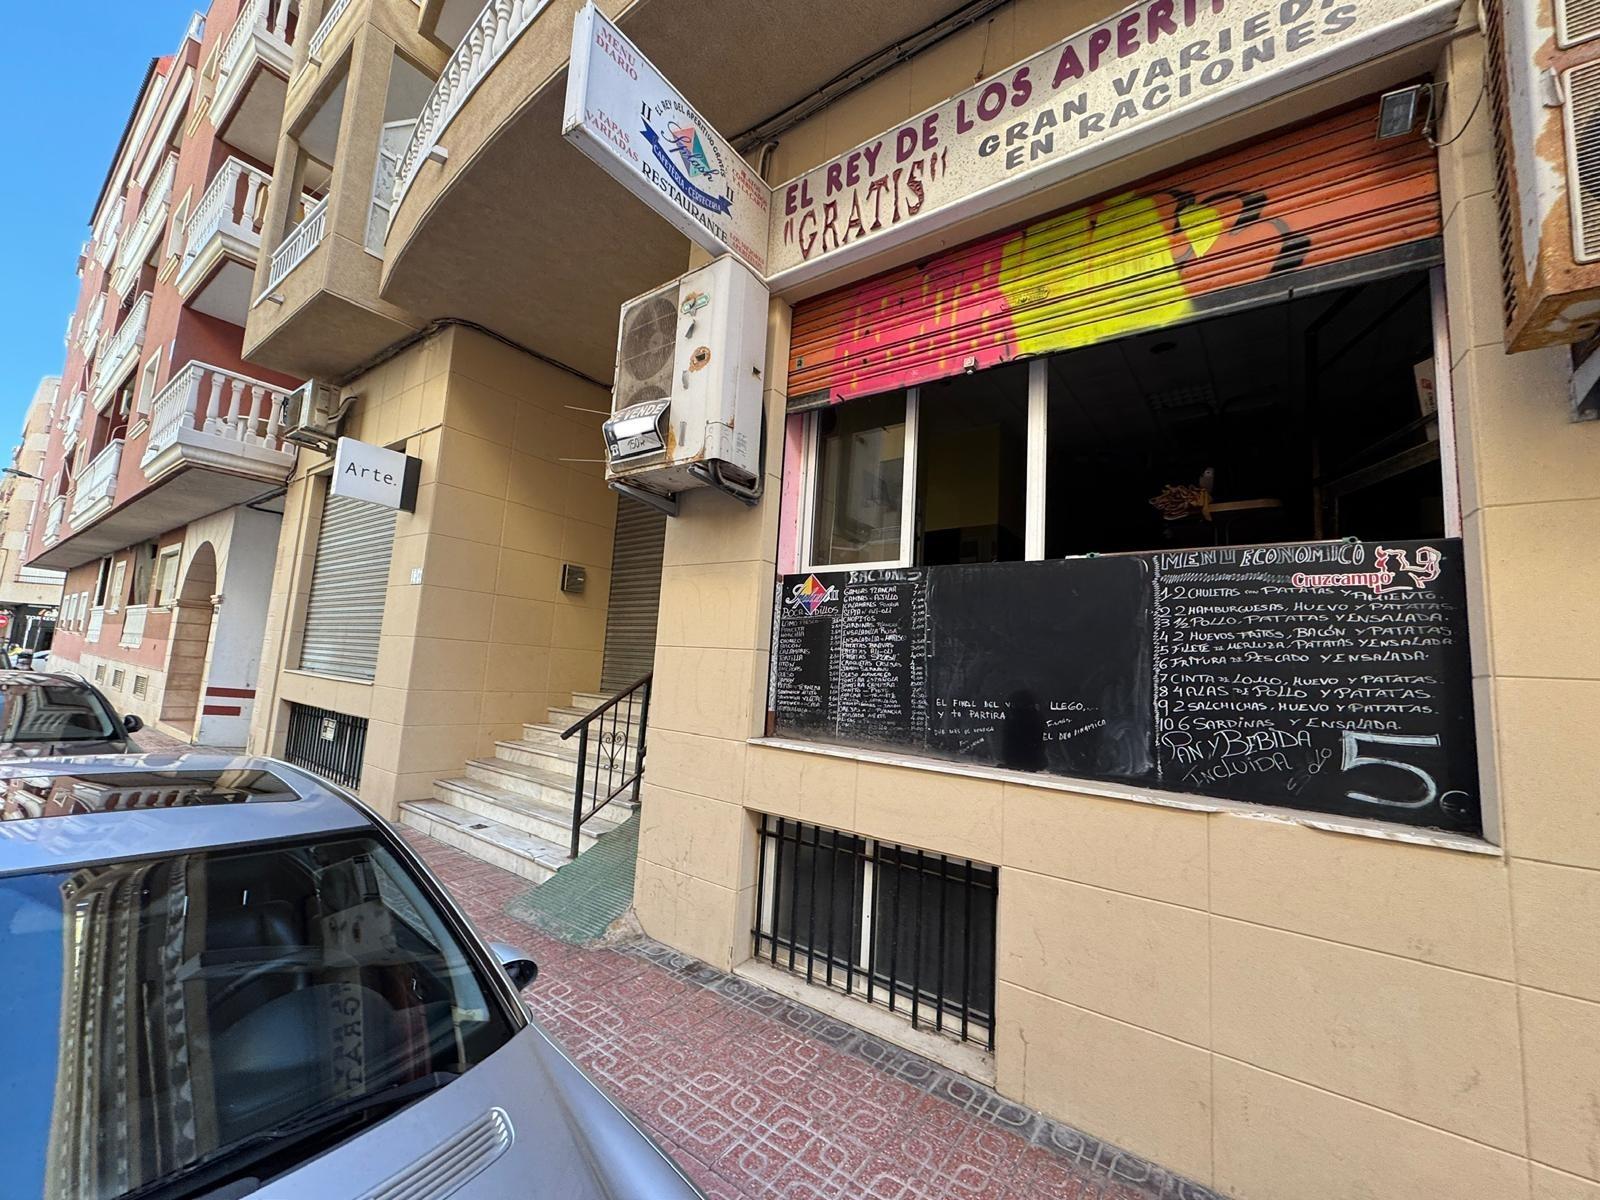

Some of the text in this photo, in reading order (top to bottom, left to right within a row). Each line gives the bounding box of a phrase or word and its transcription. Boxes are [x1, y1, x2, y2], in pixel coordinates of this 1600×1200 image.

[598, 26, 636, 66] MENU
[596, 34, 638, 81] DIARIO
[978, 0, 1335, 158] GRAN VARIED
[1006, 4, 1358, 171] EN RACIONES
[673, 101, 686, 114] DEL
[585, 108, 639, 162] VARIADAS
[598, 108, 630, 143] TAPAS
[785, 179, 813, 216] EL
[826, 141, 882, 197] REY
[896, 113, 939, 164] DE
[956, 67, 1032, 136] LOS
[642, 160, 728, 245] RESTAURANTE
[624, 403, 667, 420] VENDE
[345, 462, 398, 486] Arte.
[1160, 549, 1236, 570] MENU
[1187, 588, 1240, 599] CHULETAS
[1261, 586, 1334, 595] PATATAS
[1291, 572, 1394, 594] Cruzcampo
[1160, 606, 1172, 618] 2
[1174, 605, 1187, 616] 2
[1293, 602, 1348, 611] HUEVO
[1160, 618, 1170, 628] 3
[1243, 614, 1329, 624] PATATAS
[1336, 614, 1345, 623] Y
[1160, 631, 1168, 643] 4
[1173, 631, 1184, 642] 2
[1189, 631, 1235, 641] HUEVOS
[1355, 628, 1367, 636] Y
[1366, 625, 1453, 636] PATATAS
[1160, 645, 1169, 656] 5
[1171, 642, 1210, 655] FILETE
[1290, 639, 1354, 649] PATATAS
[1358, 639, 1368, 648] Y
[1159, 657, 1168, 670] 6
[1170, 656, 1227, 668] FRITURA
[1244, 651, 1310, 664] PESCADO
[1320, 654, 1332, 664] Y
[1160, 673, 1168, 684] 7
[1170, 673, 1215, 685] CINTA
[1293, 676, 1339, 686] HUEVO
[1347, 677, 1359, 685] Y
[1160, 685, 1168, 697] 8
[1173, 685, 1183, 697] 4
[1186, 685, 1229, 697] ALAS
[1251, 684, 1308, 698] POLLO
[1320, 688, 1332, 698] Y
[936, 698, 948, 707] EL
[1158, 699, 1168, 716] 9
[1173, 700, 1186, 712] 2
[1278, 702, 1329, 712] HUEVO
[1336, 704, 1347, 712] Y
[1160, 718, 1174, 732] 10
[1178, 716, 1191, 730] 6
[1042, 732, 1053, 741] EL
[1161, 731, 1203, 763] PAN
[1213, 728, 1312, 759] BEBIDA
[1182, 752, 1293, 784] INCLUIDA
[1341, 730, 1441, 809] 5
